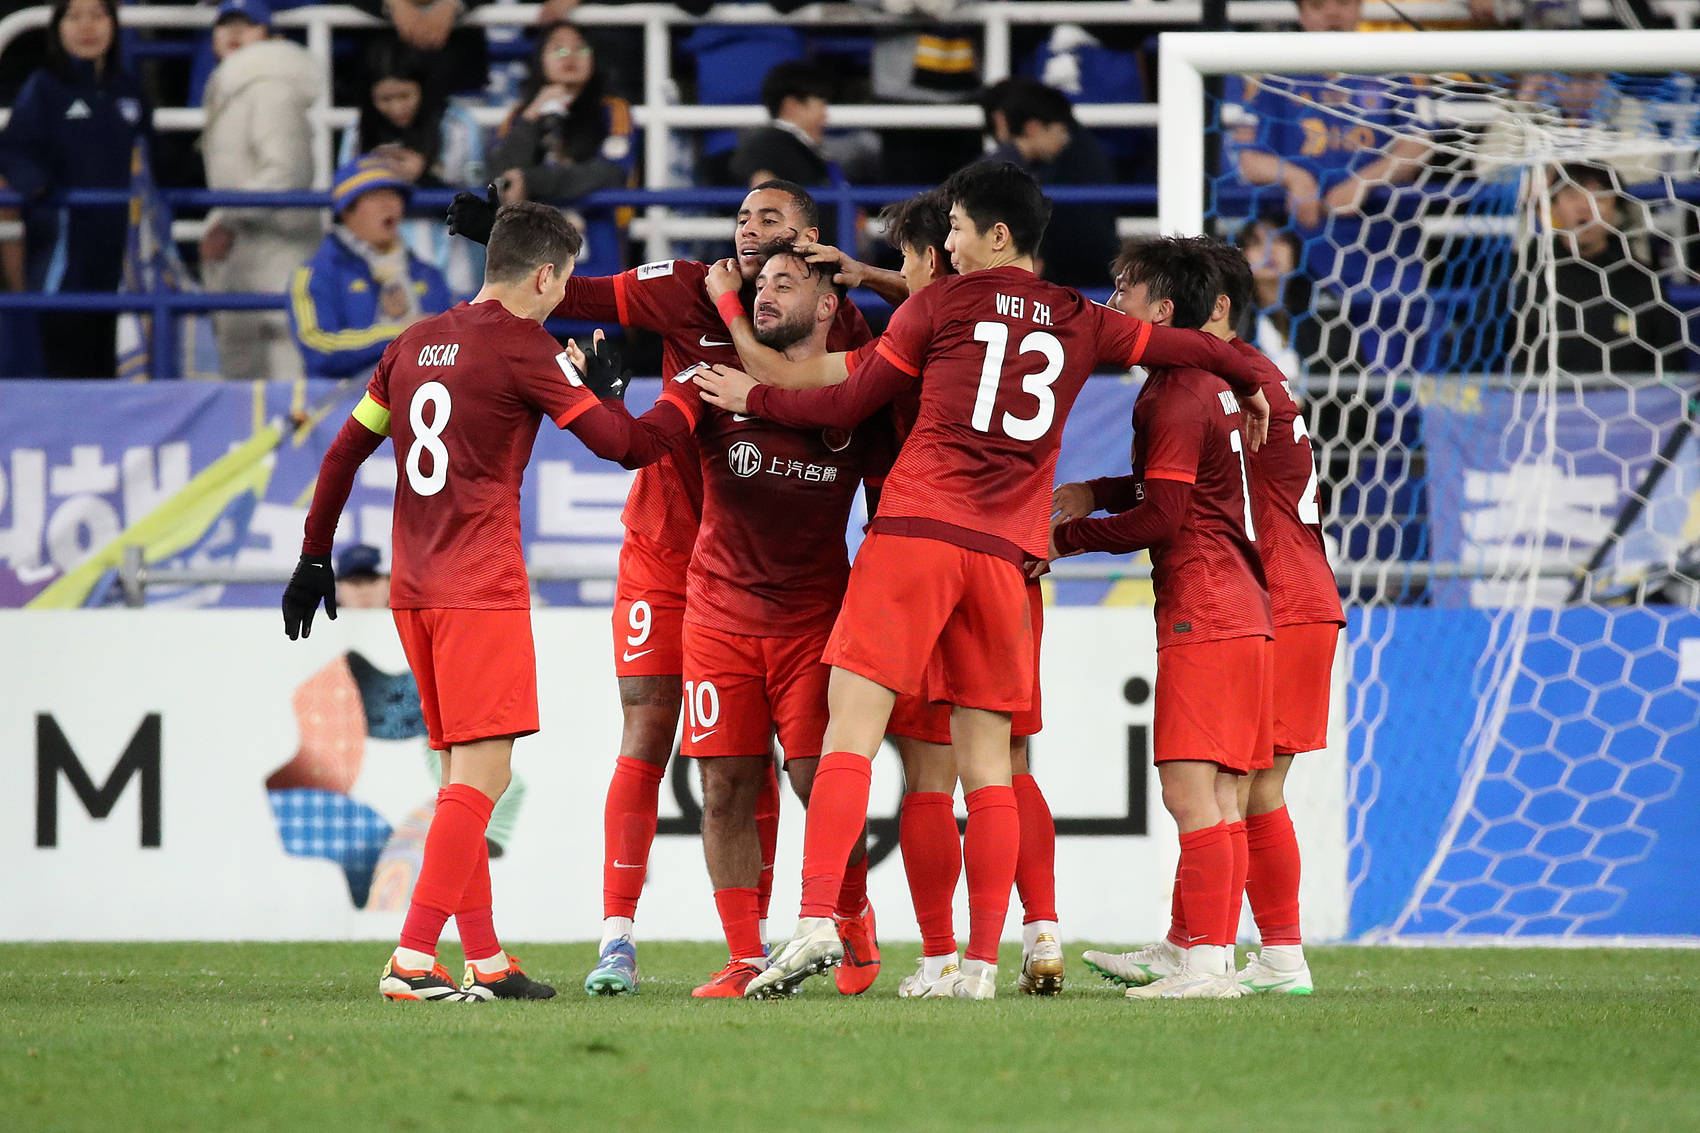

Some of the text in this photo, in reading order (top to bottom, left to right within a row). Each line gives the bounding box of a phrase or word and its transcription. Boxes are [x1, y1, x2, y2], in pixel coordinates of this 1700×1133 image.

[996, 293, 1054, 326] WEI ZH.
[418, 344, 460, 367] OSCAR
[971, 321, 1065, 441] 13
[405, 381, 452, 497] 8
[728, 441, 837, 482] MG 上汽名爵
[627, 600, 652, 646] 9
[685, 681, 719, 728] 10
[35, 711, 161, 849] M
